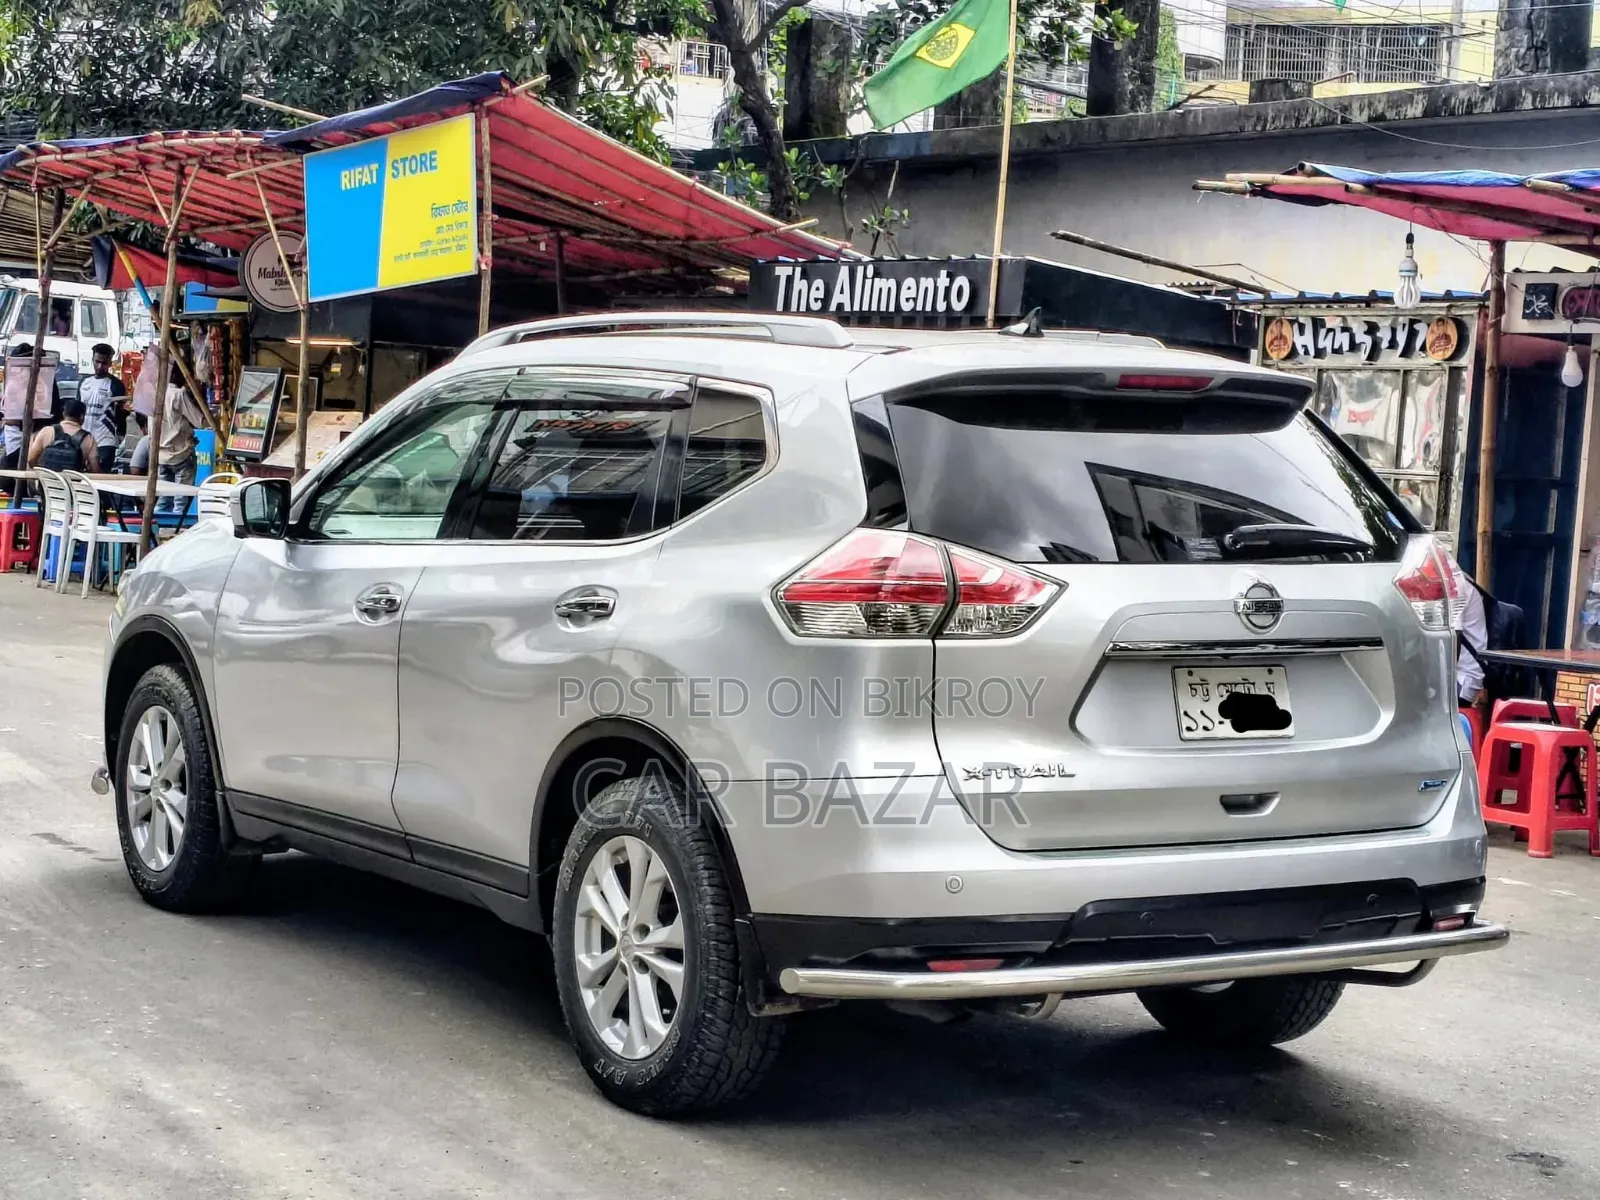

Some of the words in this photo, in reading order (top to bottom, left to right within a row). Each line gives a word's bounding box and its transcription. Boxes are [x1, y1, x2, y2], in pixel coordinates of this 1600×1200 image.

[341, 163, 379, 191] RIFAT
[391, 150, 438, 179] STORE
[774, 266, 825, 312] The
[829, 264, 970, 312] Alimento
[1242, 602, 1282, 611] NISSAN
[961, 762, 1076, 781] X-TRAIL
